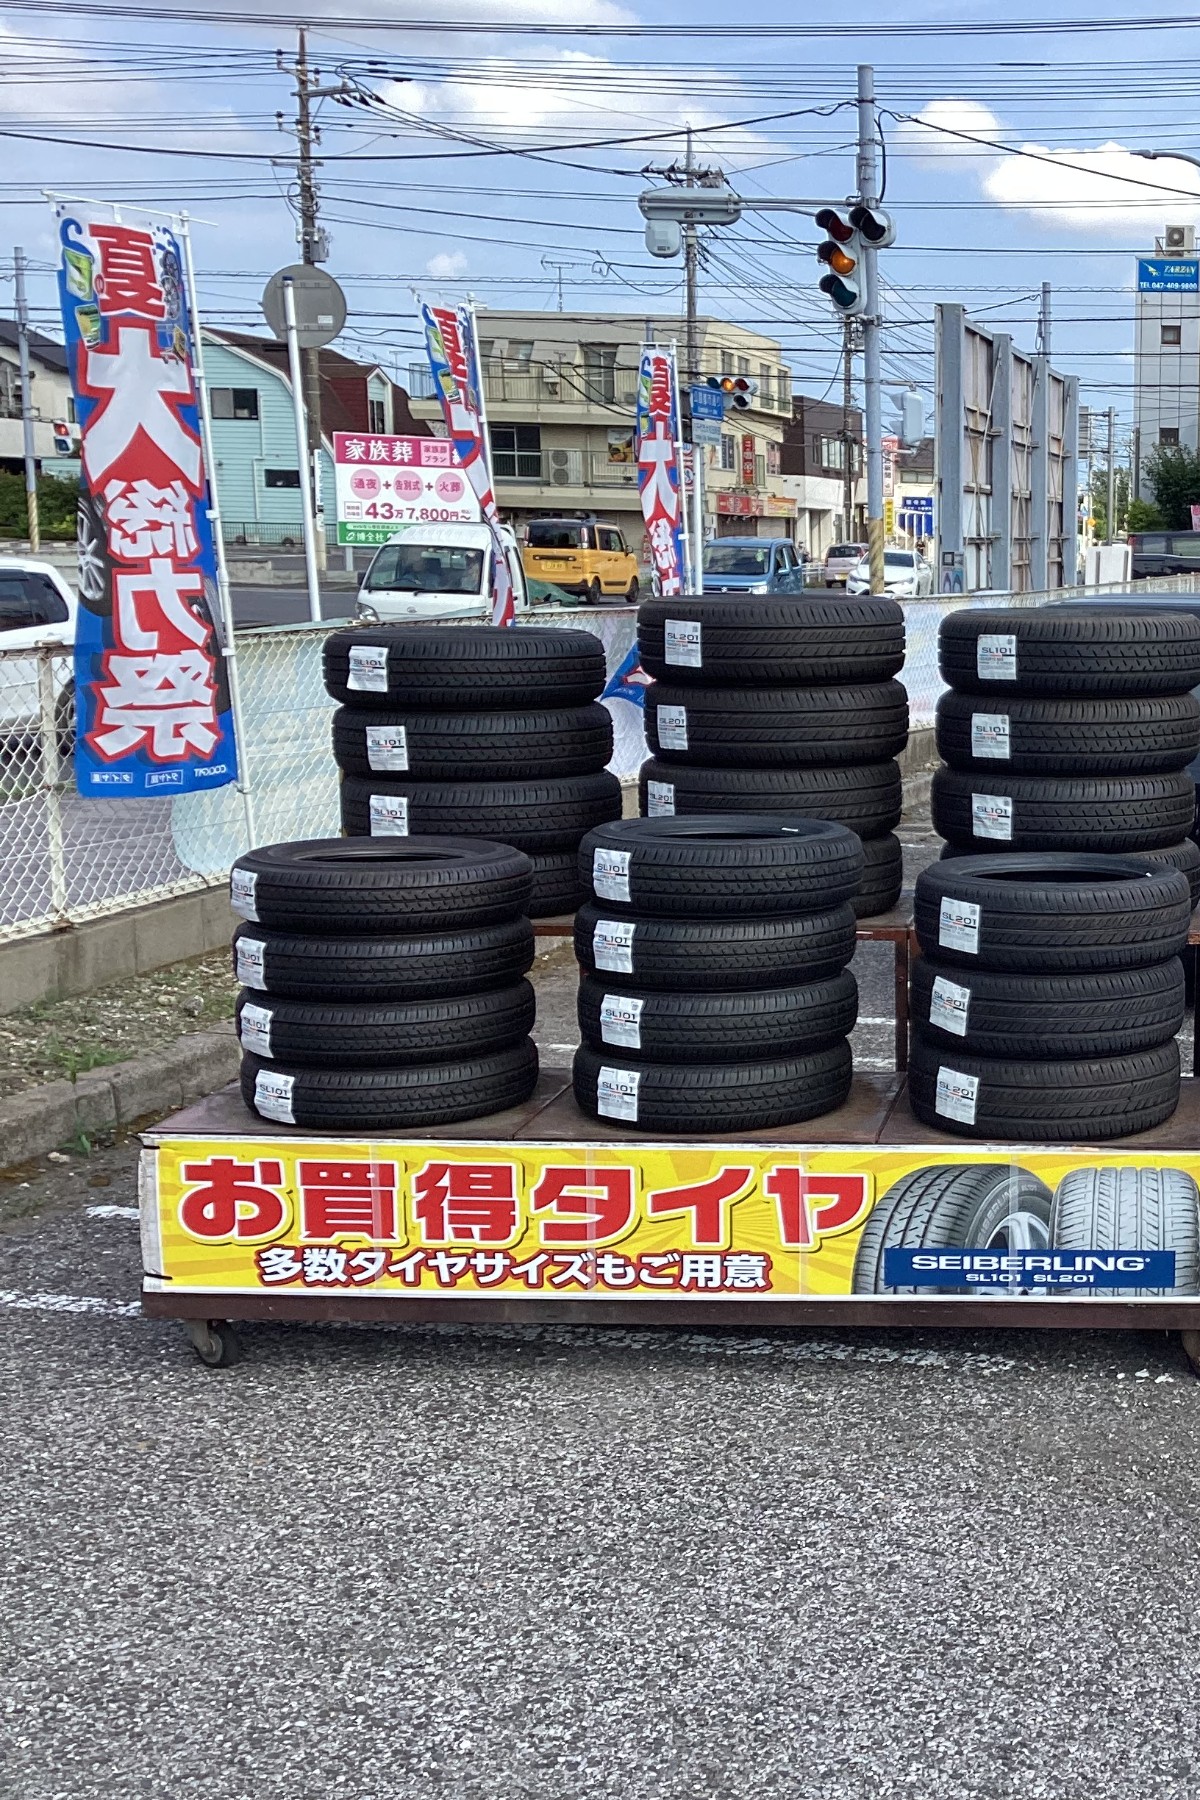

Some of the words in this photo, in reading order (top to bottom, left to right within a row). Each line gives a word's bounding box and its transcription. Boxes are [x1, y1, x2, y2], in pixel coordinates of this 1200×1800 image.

[344, 438, 413, 462] 家族葬
[353, 477, 377, 490] 通夜
[395, 480, 421, 492] 告別式
[439, 481, 461, 493] 火葬
[667, 632, 700, 642] SL201
[981, 646, 1012, 655] SL101
[352, 658, 382, 667] SL101
[658, 717, 686, 726] SL201
[975, 725, 1006, 734] SL101
[371, 738, 402, 747] SL101
[374, 807, 403, 818] SL101
[976, 804, 1008, 816] SL101
[596, 862, 626, 874] SL101
[942, 911, 977, 926] SL201
[598, 934, 629, 945] SL101
[933, 990, 967, 1010] SL201
[605, 1007, 637, 1021] SL101
[259, 1083, 289, 1097] SL101
[601, 1080, 635, 1093] SL101
[938, 1080, 975, 1099] SL201
[179, 1157, 867, 1246] お買得タイヤ
[259, 1248, 768, 1289] 多数タイヤサイズもご用意
[911, 1255, 1146, 1271] SEIBERLING
[965, 1273, 1022, 1283] SL101
[1032, 1273, 1095, 1284] SL201
